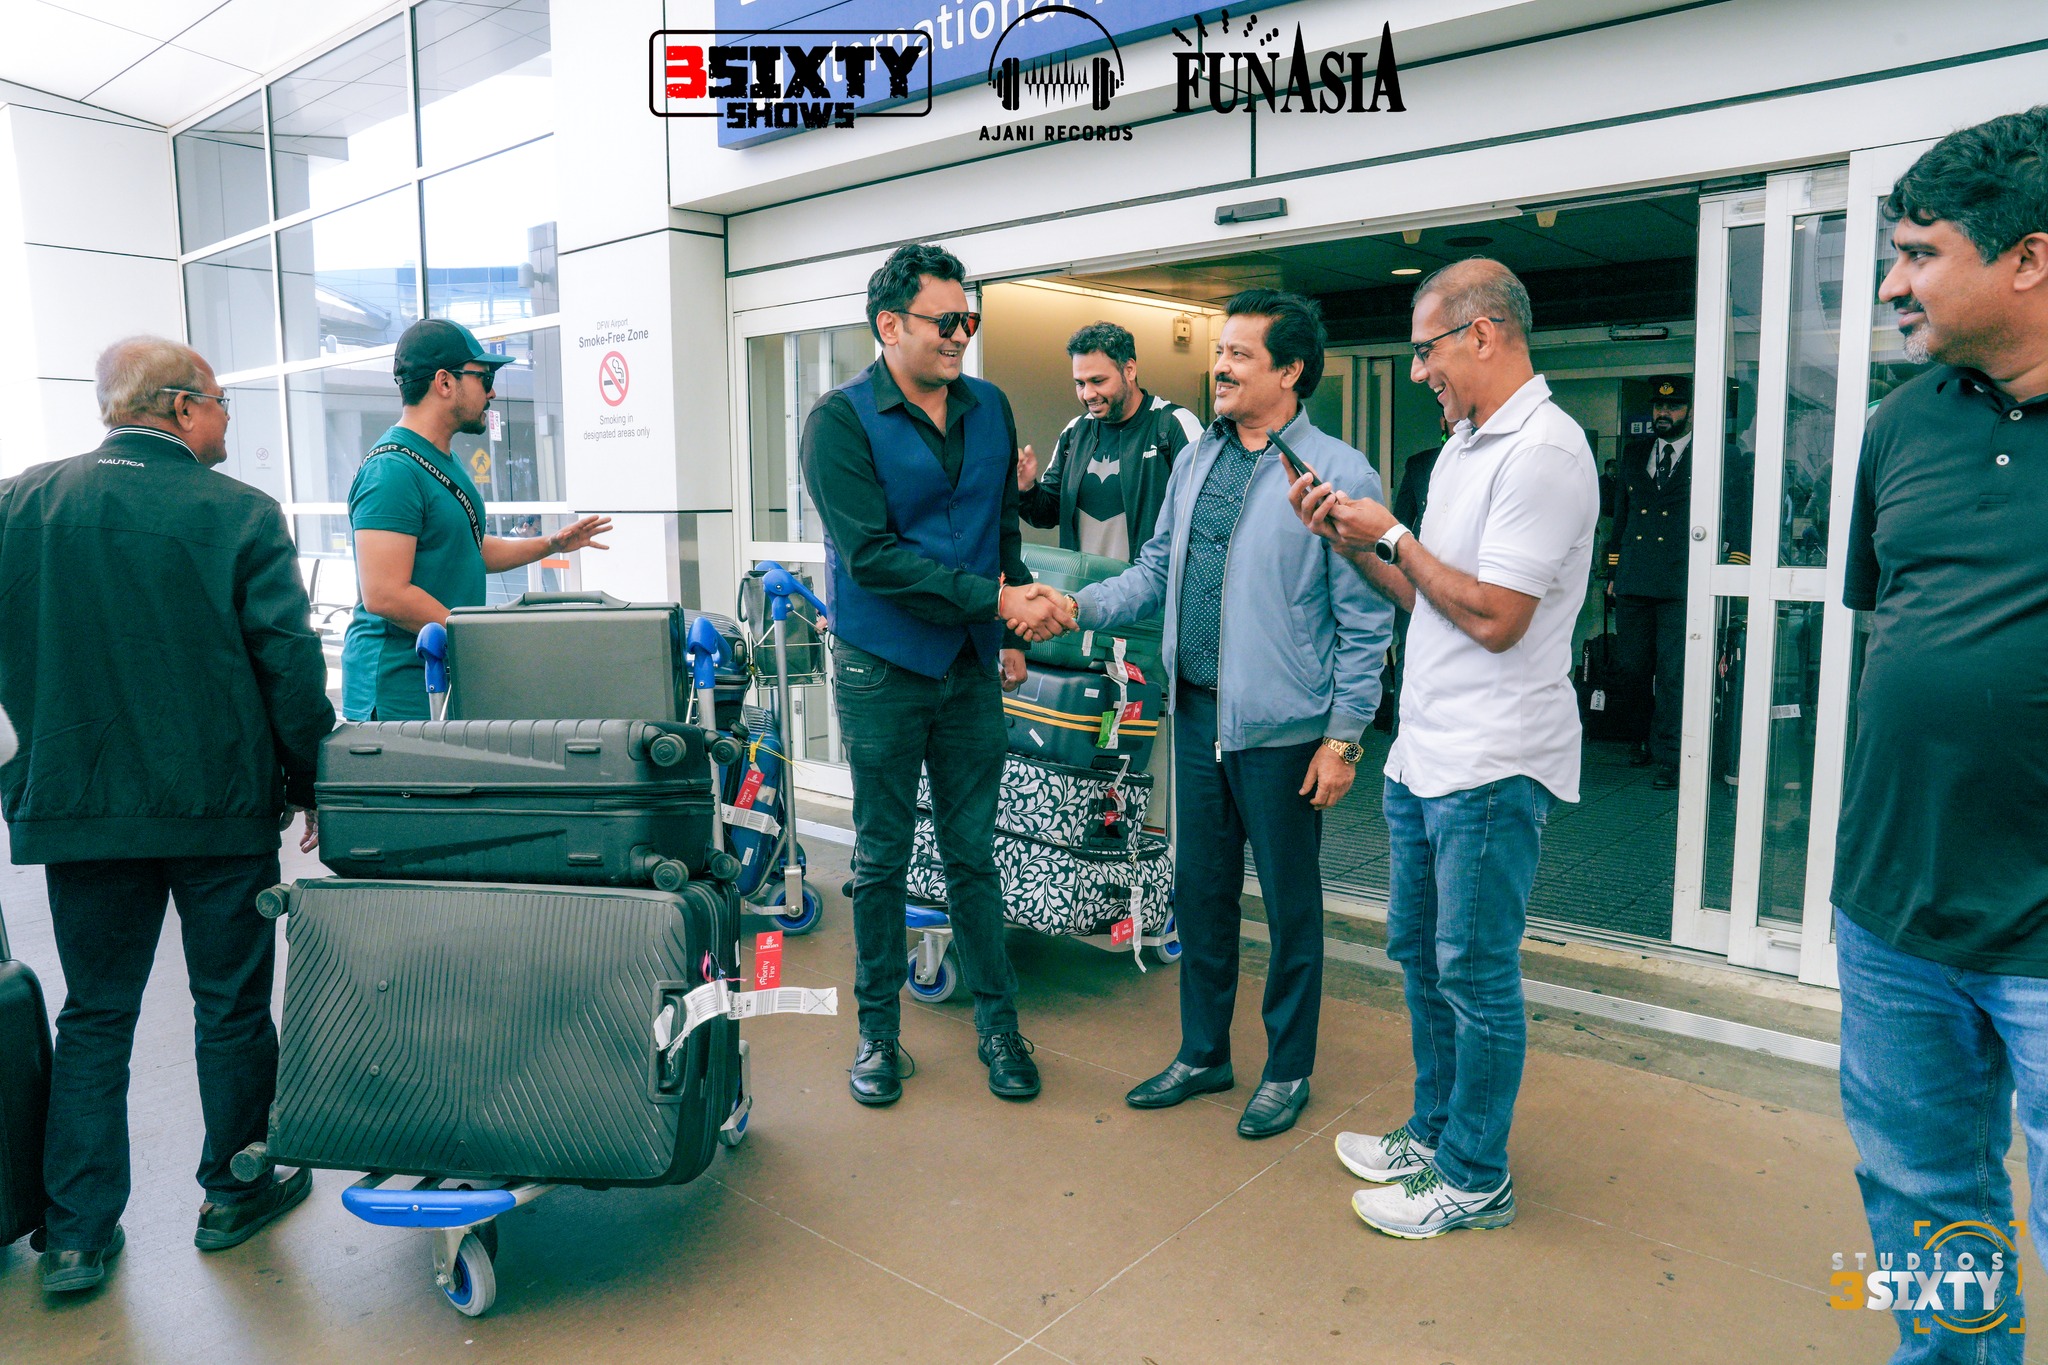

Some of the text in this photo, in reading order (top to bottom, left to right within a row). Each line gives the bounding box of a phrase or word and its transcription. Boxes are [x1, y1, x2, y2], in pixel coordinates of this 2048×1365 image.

[597, 318, 628, 330] DFW Airport
[579, 329, 649, 348] Smoke-Free Zone
[600, 413, 633, 426] Smoking in
[584, 426, 650, 442] designated areas only
[97, 458, 145, 468] NAUTICA
[361, 444, 451, 487] NDER ARMOUR
[456, 488, 477, 525] UNDER
[760, 960, 770, 985] Priority
